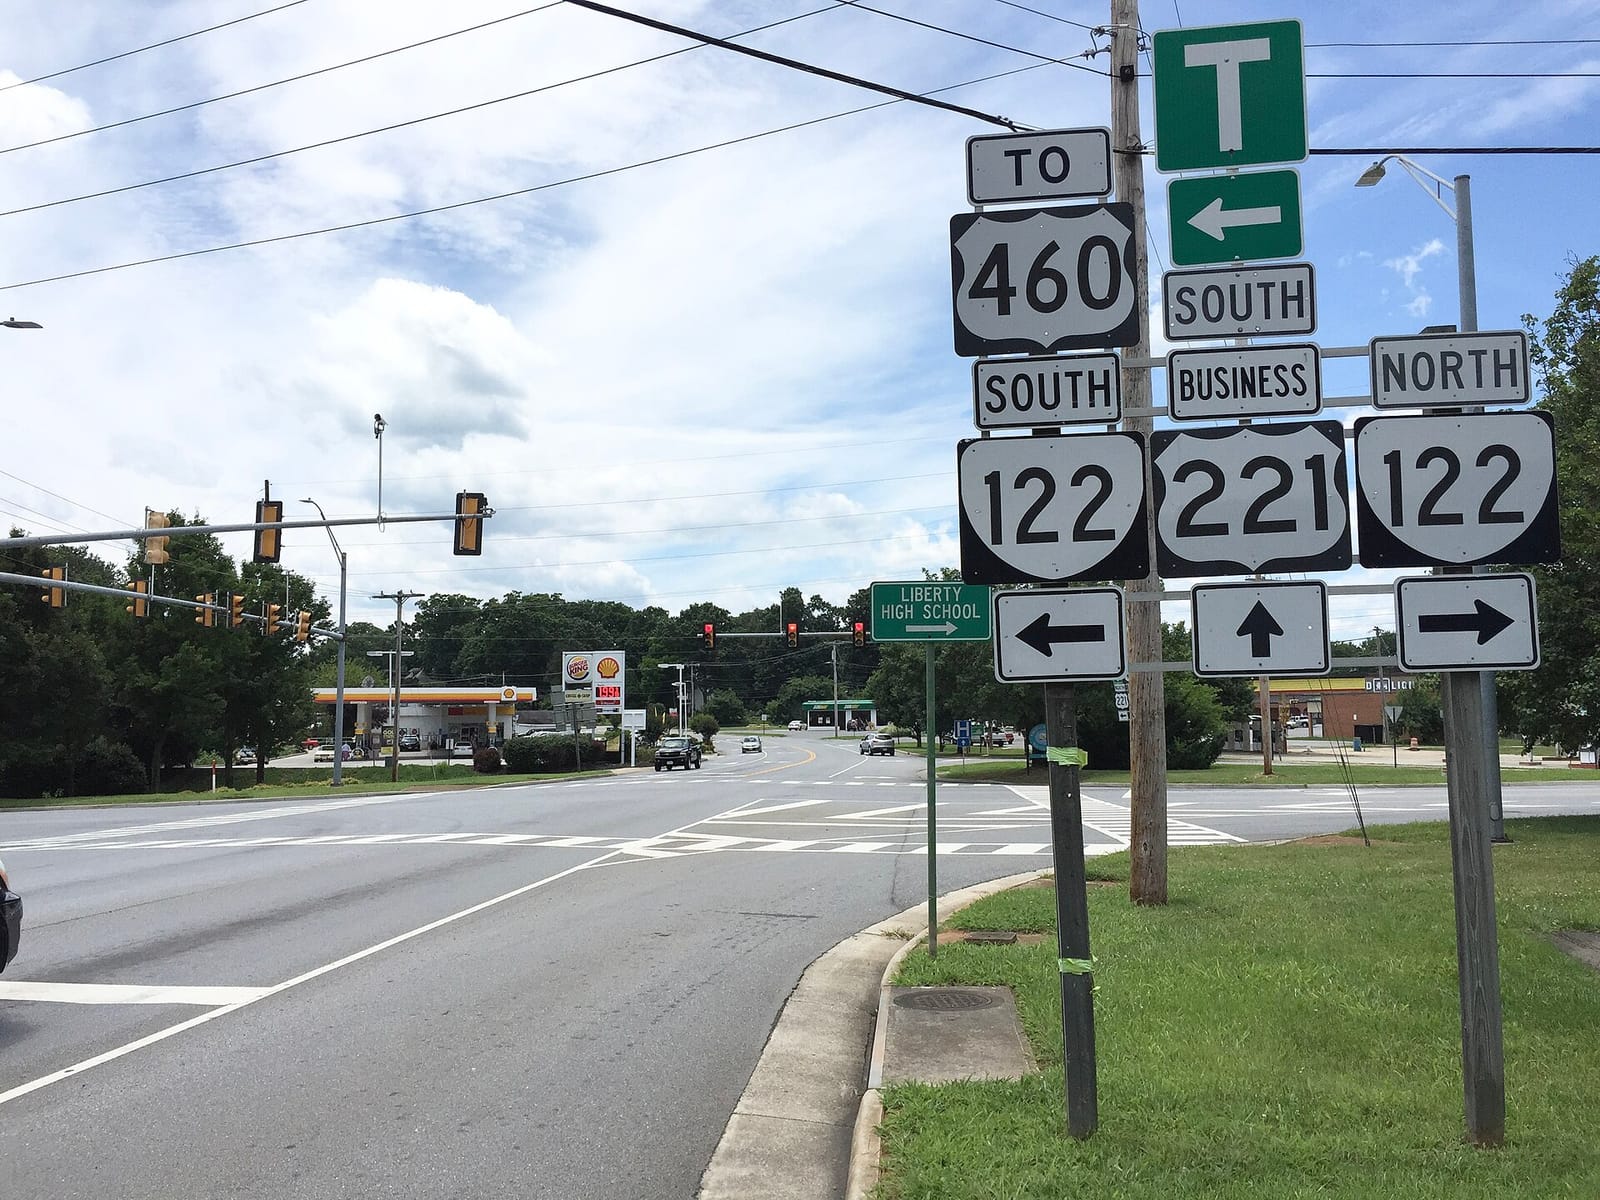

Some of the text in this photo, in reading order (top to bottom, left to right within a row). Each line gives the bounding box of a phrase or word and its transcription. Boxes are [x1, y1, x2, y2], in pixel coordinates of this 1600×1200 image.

[1184, 38, 1271, 153] T
[1003, 145, 1071, 187] TO
[968, 234, 1122, 316] 460
[1174, 279, 1305, 325] SOUTH
[985, 369, 1111, 414] SOUTH
[1179, 363, 1308, 402] BUSINESS
[1381, 348, 1518, 393] NORTH
[984, 464, 1116, 546] 122
[1172, 453, 1329, 538] 221
[1383, 443, 1525, 528] 122
[881, 603, 981, 620] HIGH SCHOOL
[901, 586, 962, 602] LIBERTY
[569, 664, 589, 676] KING
[1116, 695, 1128, 706] 221
